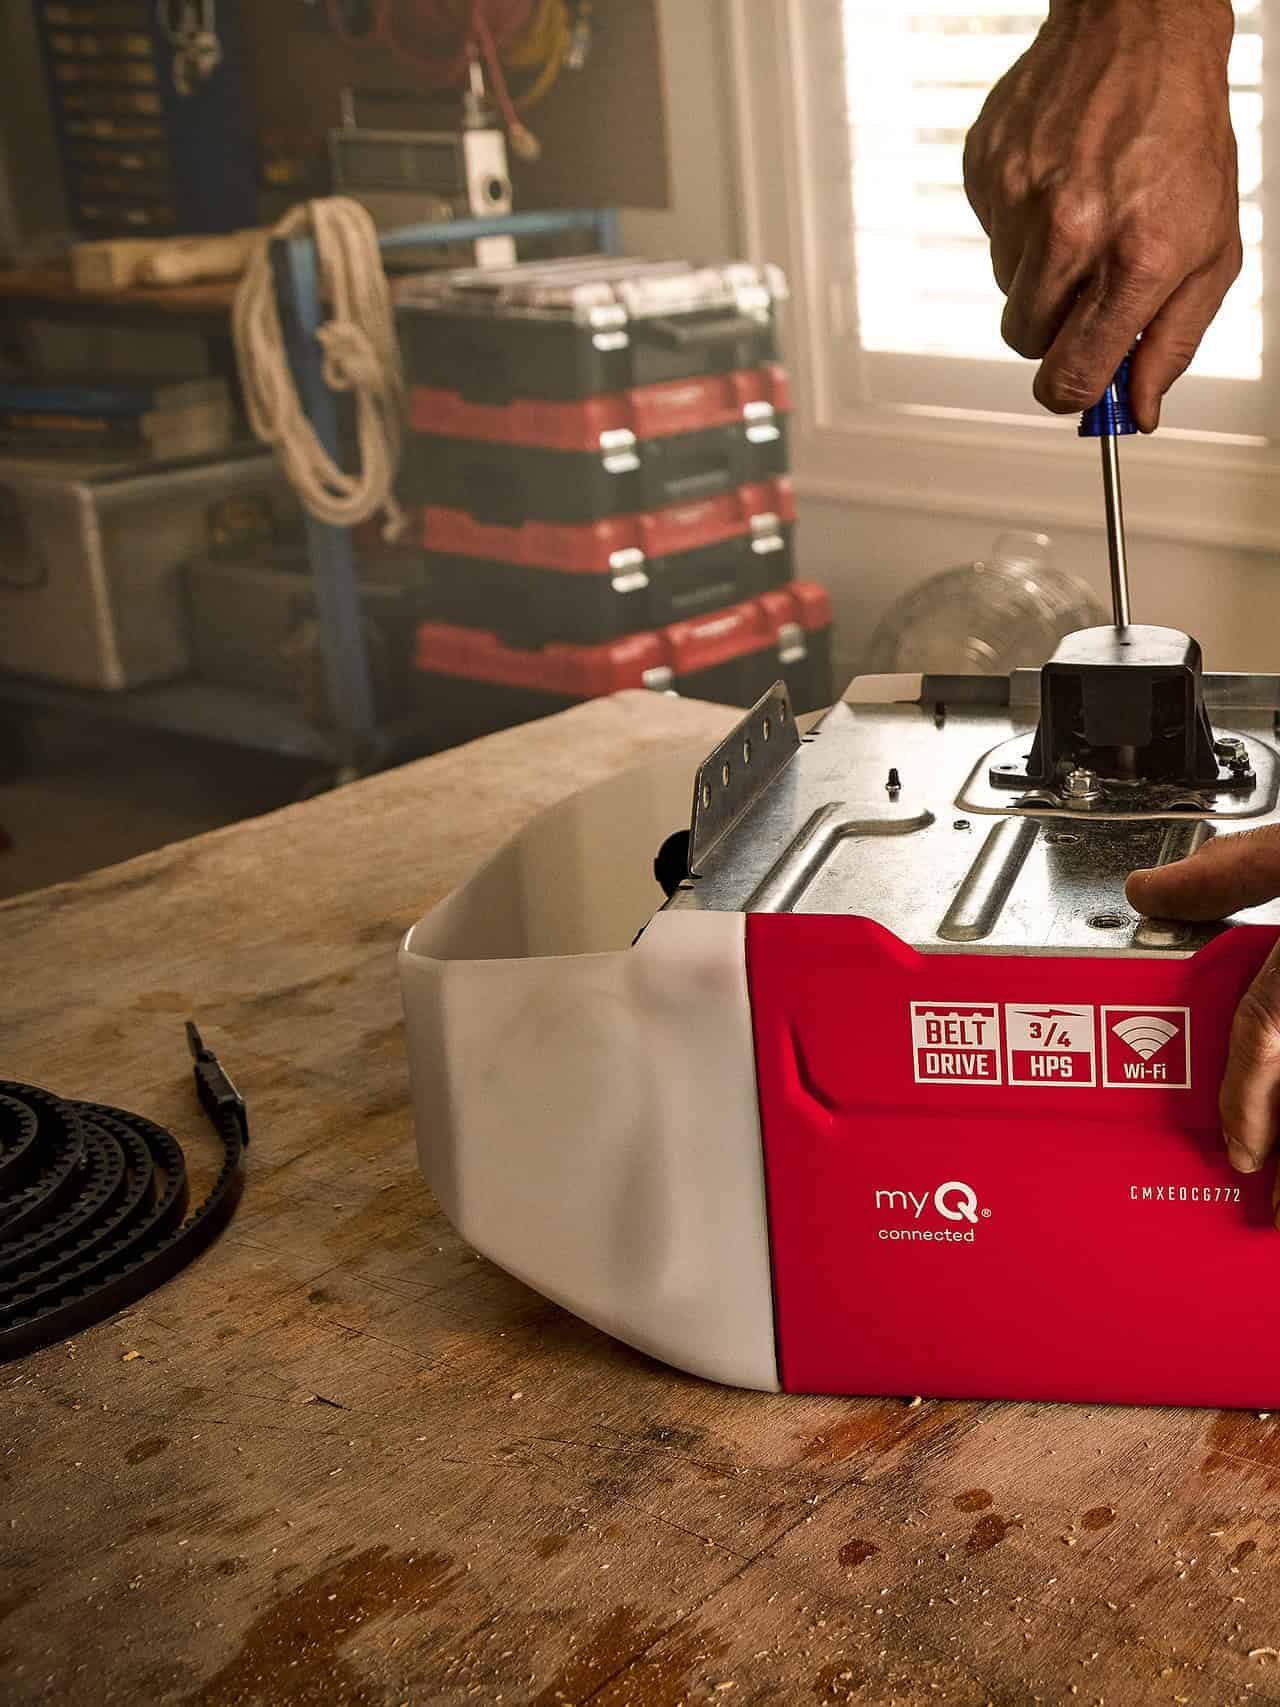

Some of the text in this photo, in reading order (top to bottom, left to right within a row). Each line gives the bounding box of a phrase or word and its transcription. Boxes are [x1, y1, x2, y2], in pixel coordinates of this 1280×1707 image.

[926, 1020, 986, 1045] BELT
[1029, 1022, 1072, 1048] 3/4
[926, 1053, 989, 1076] DRIVE
[1030, 1056, 1073, 1078] HPS
[1124, 1063, 1167, 1080] Wi-Fi
[878, 1228, 975, 1242] connected
